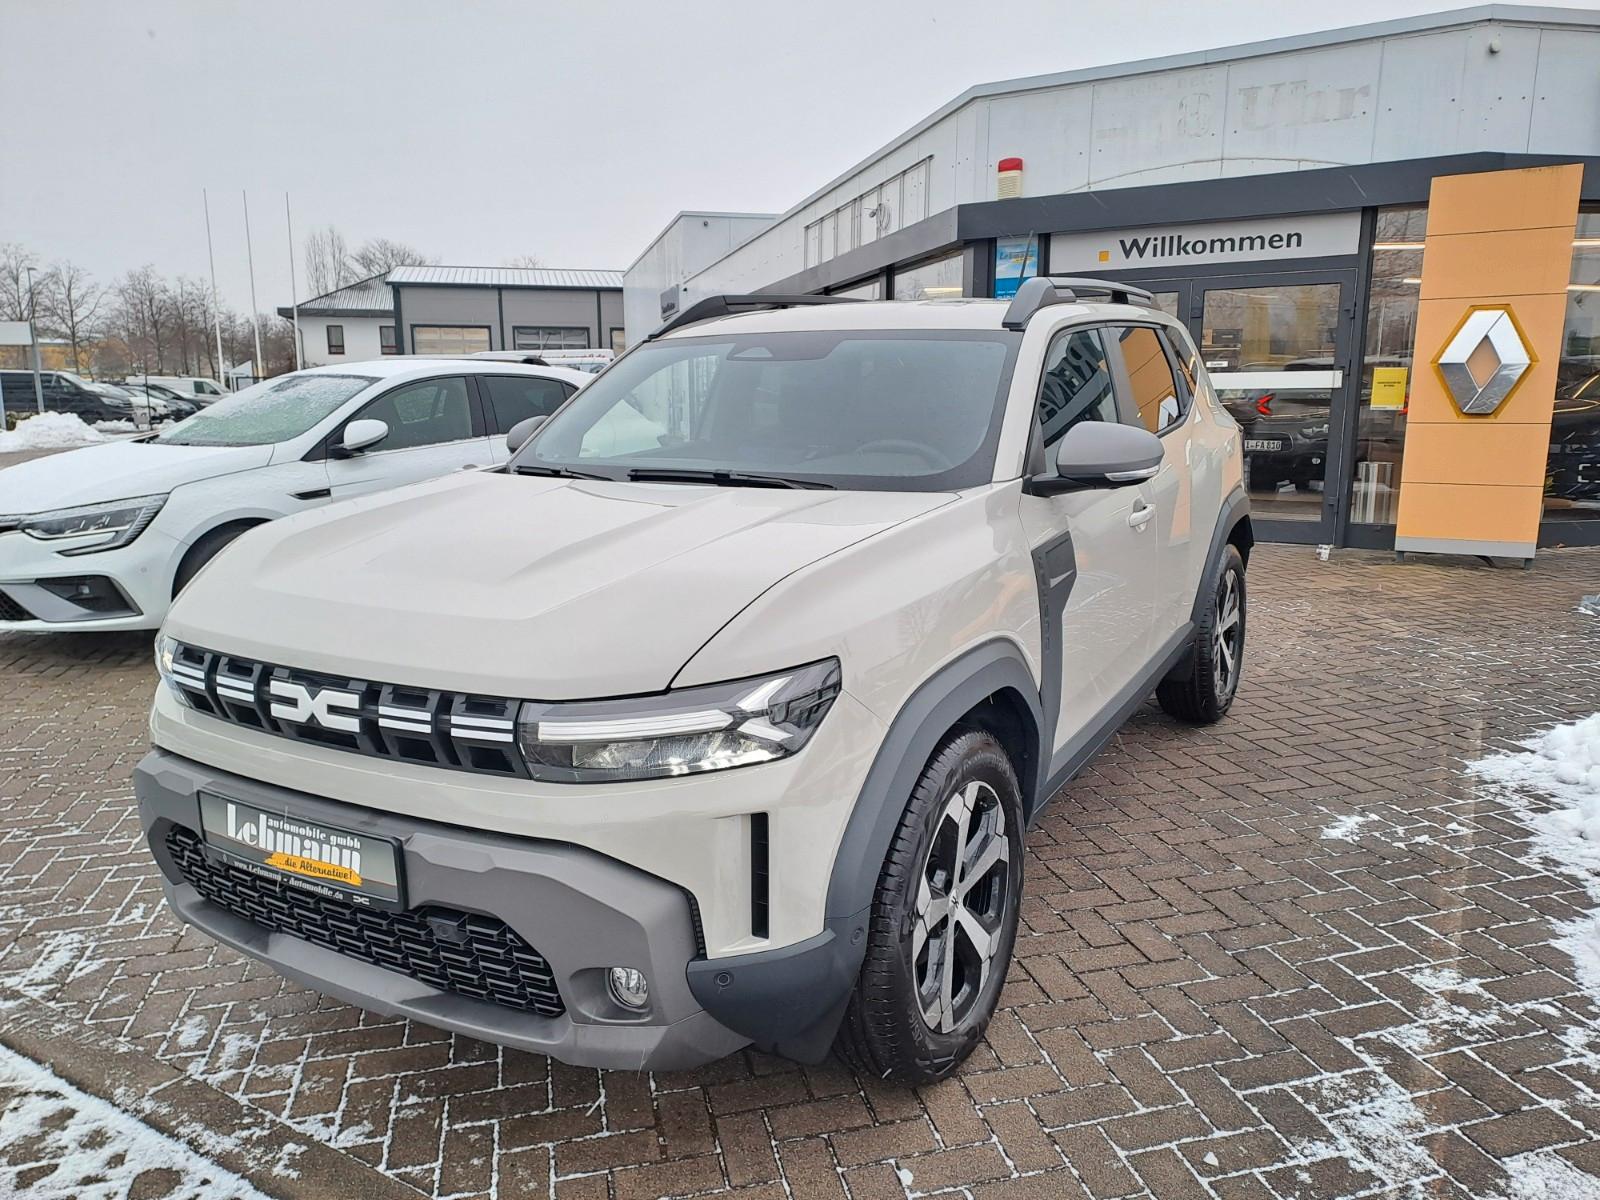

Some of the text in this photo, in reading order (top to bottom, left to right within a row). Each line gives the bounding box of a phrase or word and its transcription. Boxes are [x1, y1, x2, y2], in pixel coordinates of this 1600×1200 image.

[1119, 231, 1302, 259] Willkommen
[226, 802, 361, 875] Lehmann
[267, 818, 361, 850] automobile gmbh
[299, 859, 353, 881] Alternative!
